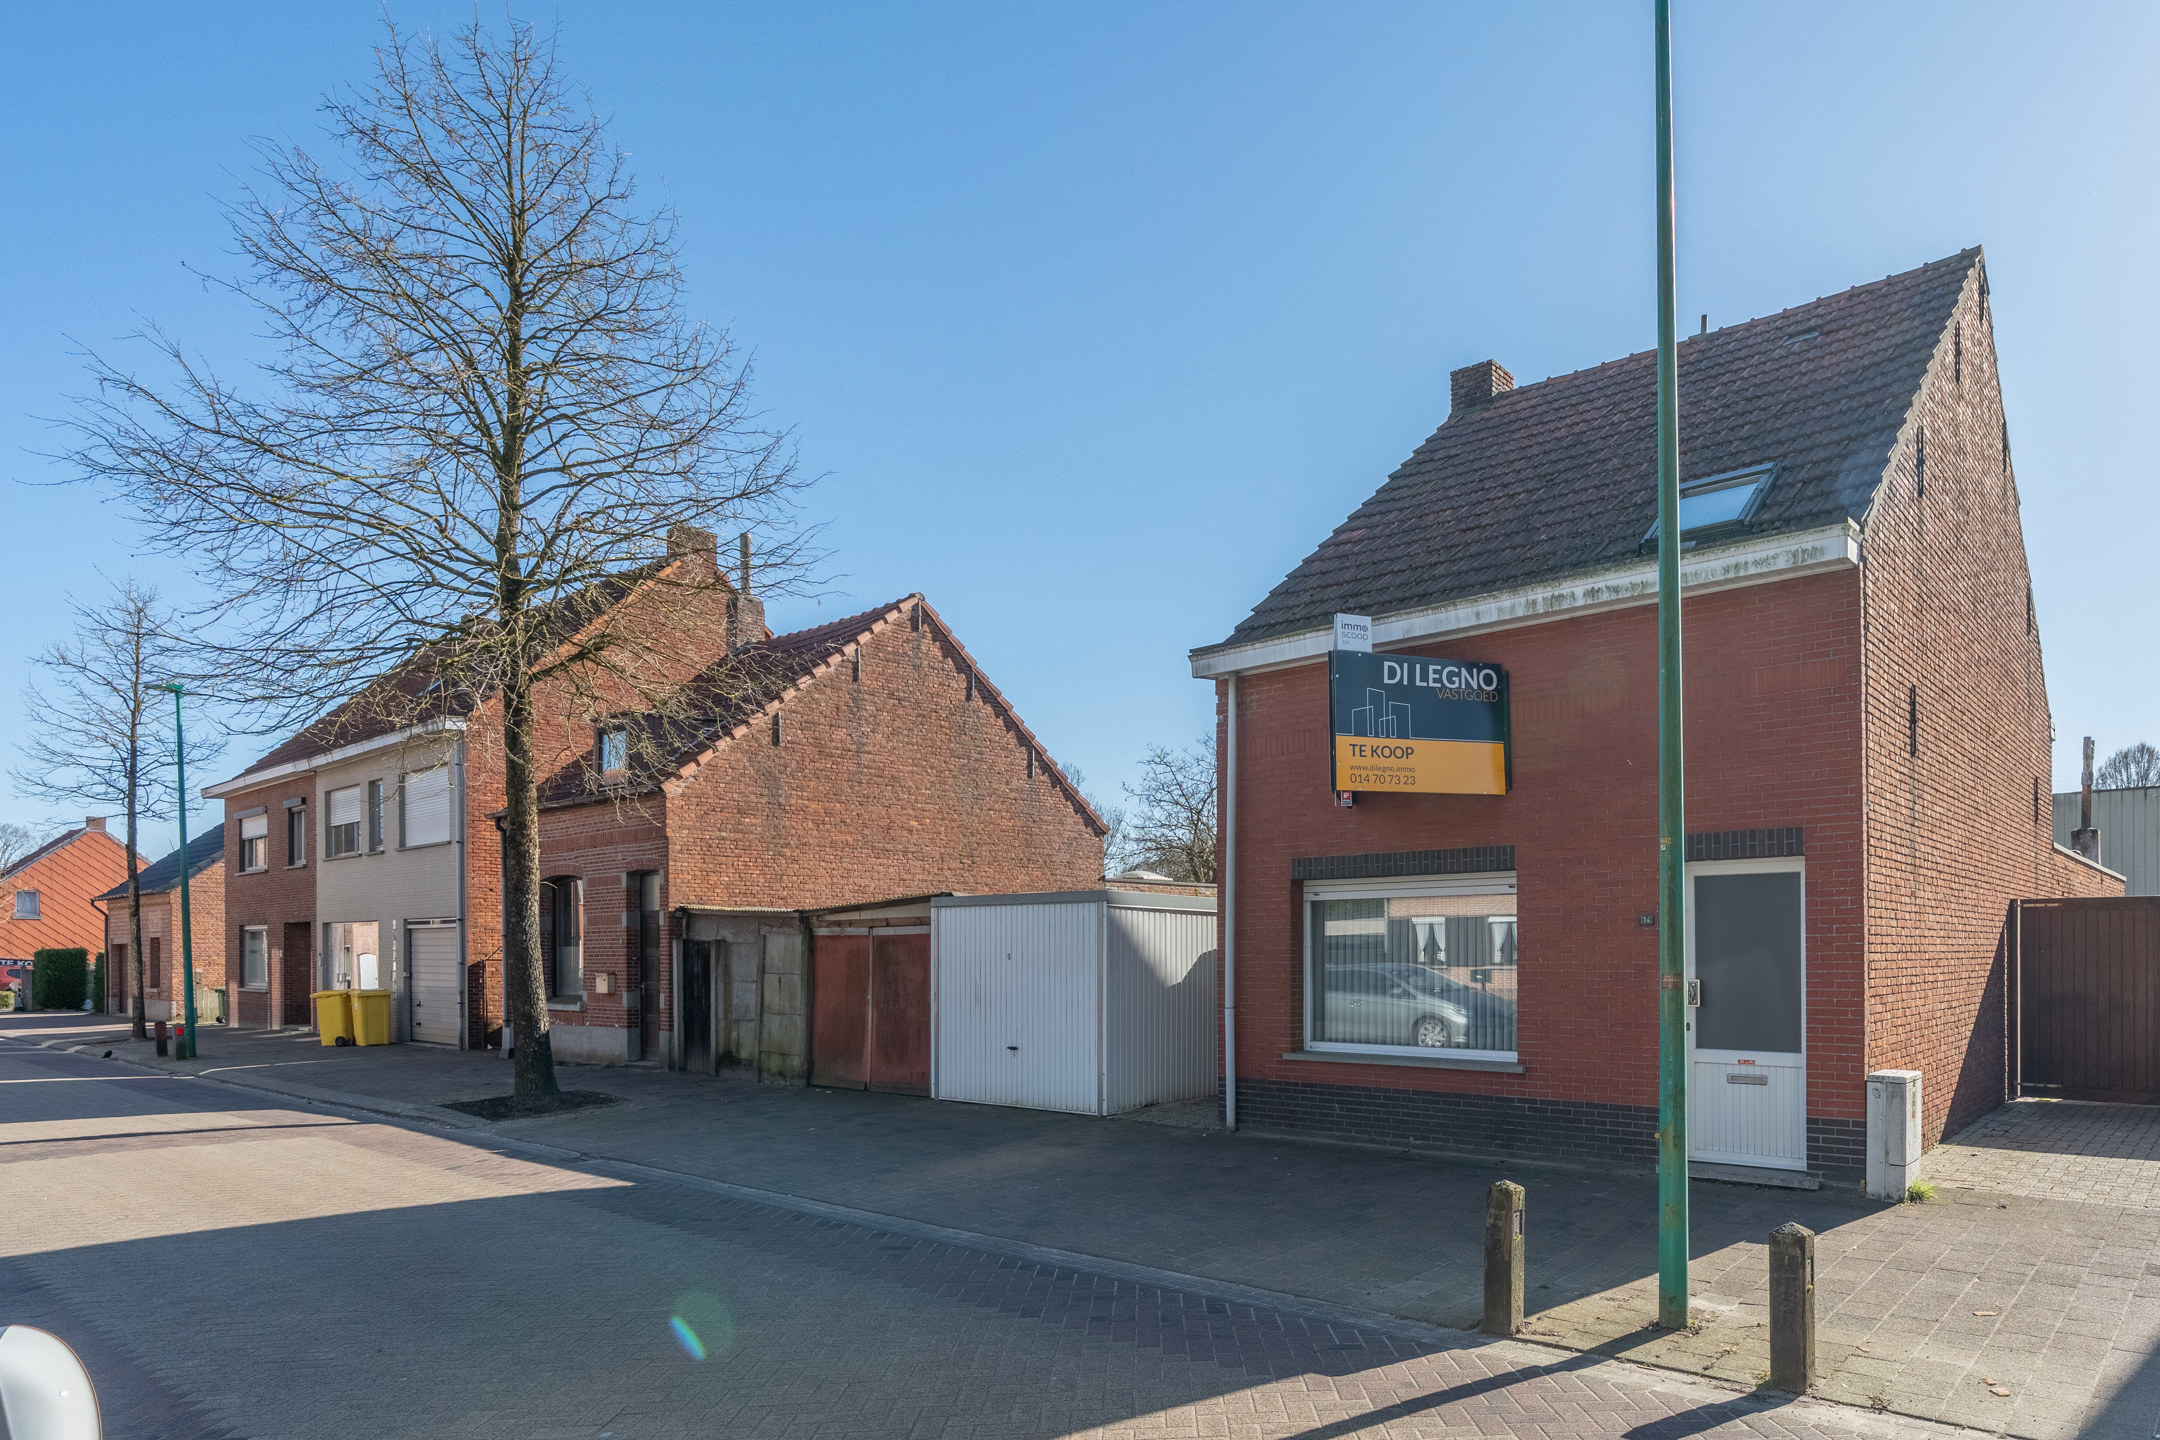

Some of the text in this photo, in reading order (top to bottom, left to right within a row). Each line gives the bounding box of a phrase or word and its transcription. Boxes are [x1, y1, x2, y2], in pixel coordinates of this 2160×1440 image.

[1341, 620, 1368, 633] immo
[1341, 631, 1369, 642] scoop
[1383, 661, 1498, 691] DI LEGNO
[1436, 687, 1499, 703] VASTGOED
[1349, 744, 1415, 759] TE KOOP
[1349, 764, 1416, 774] www.dilegno.immo
[1349, 773, 1416, 786] 014 70 73 23
